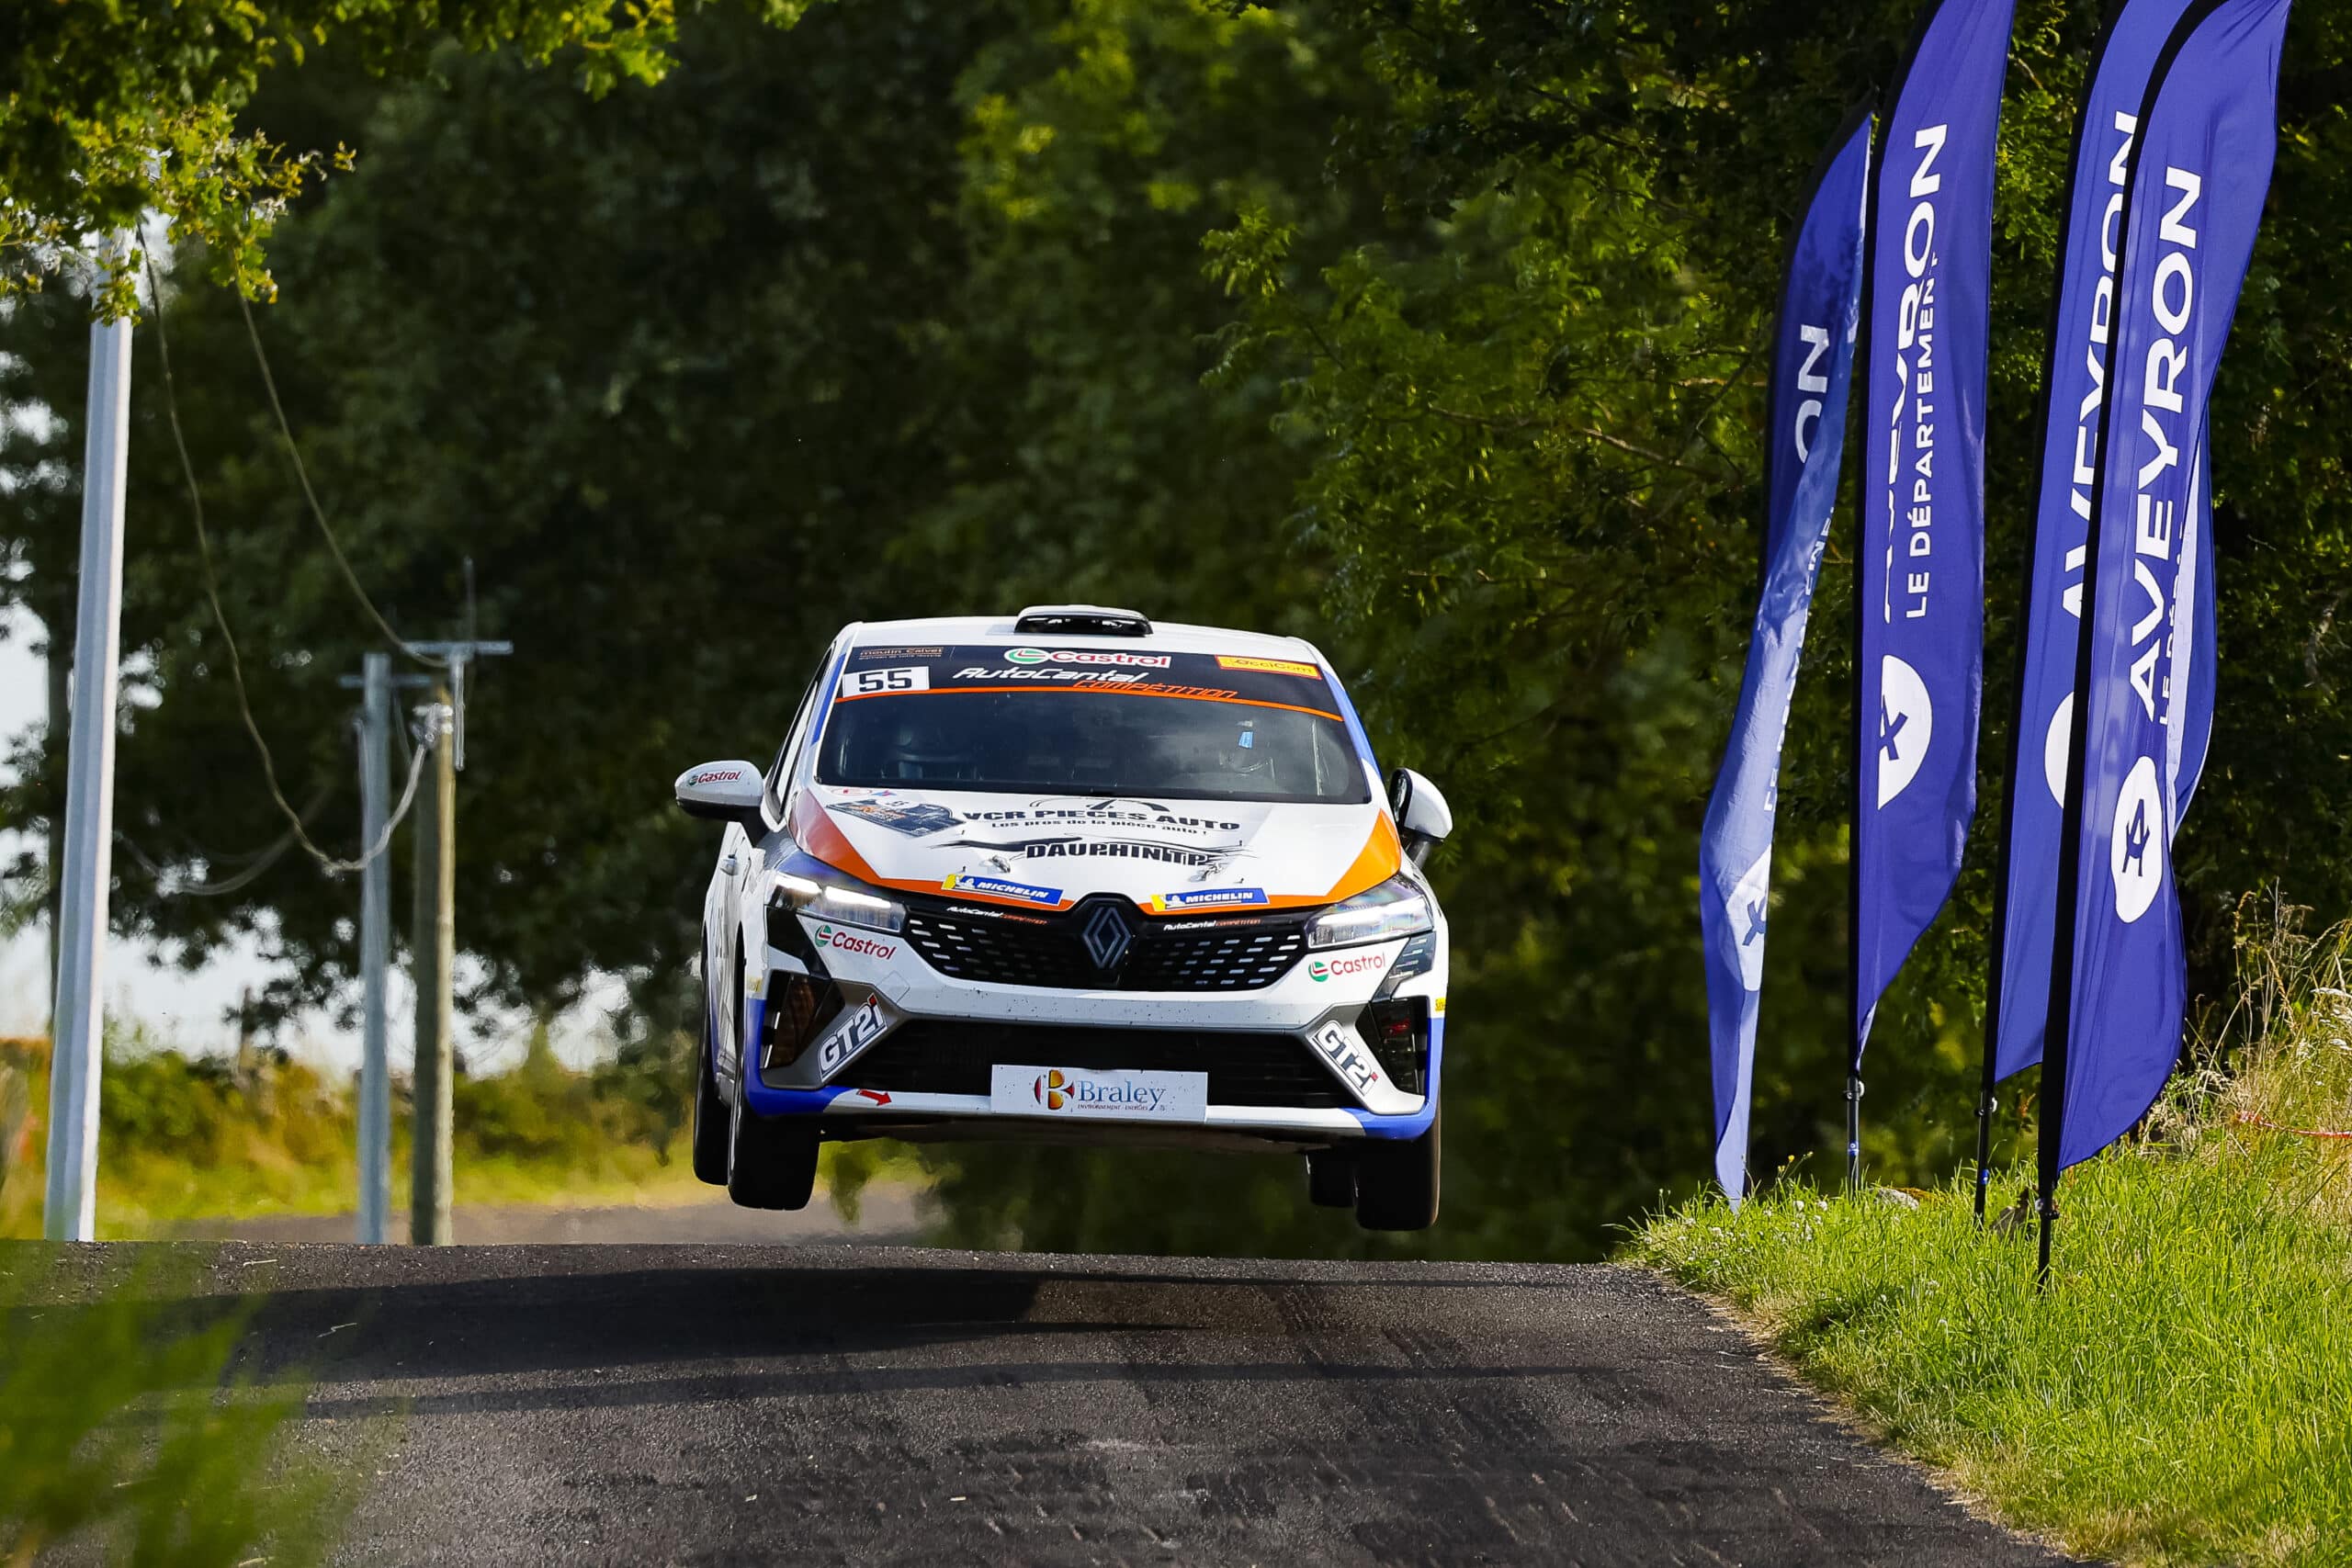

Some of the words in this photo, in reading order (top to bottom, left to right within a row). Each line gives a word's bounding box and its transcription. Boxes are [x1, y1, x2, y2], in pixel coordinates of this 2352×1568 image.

[2130, 166, 2201, 723] AVEYRON
[1906, 571, 1930, 618] LE
[1052, 651, 1170, 668] Castrol
[859, 669, 912, 693] 55
[953, 666, 1148, 682] AutoCantal
[698, 771, 742, 784] Castrol
[963, 810, 1026, 820] VCR
[1156, 815, 1241, 830] AUTO
[977, 881, 1049, 899] MICHELIN
[1185, 892, 1253, 904] MICHELIN
[831, 931, 897, 960] Castrol
[1331, 953, 1386, 976] Castrol
[819, 993, 885, 1073] GT2i
[1317, 1021, 1378, 1095] GT2i
[1078, 1080, 1166, 1111] Braley
